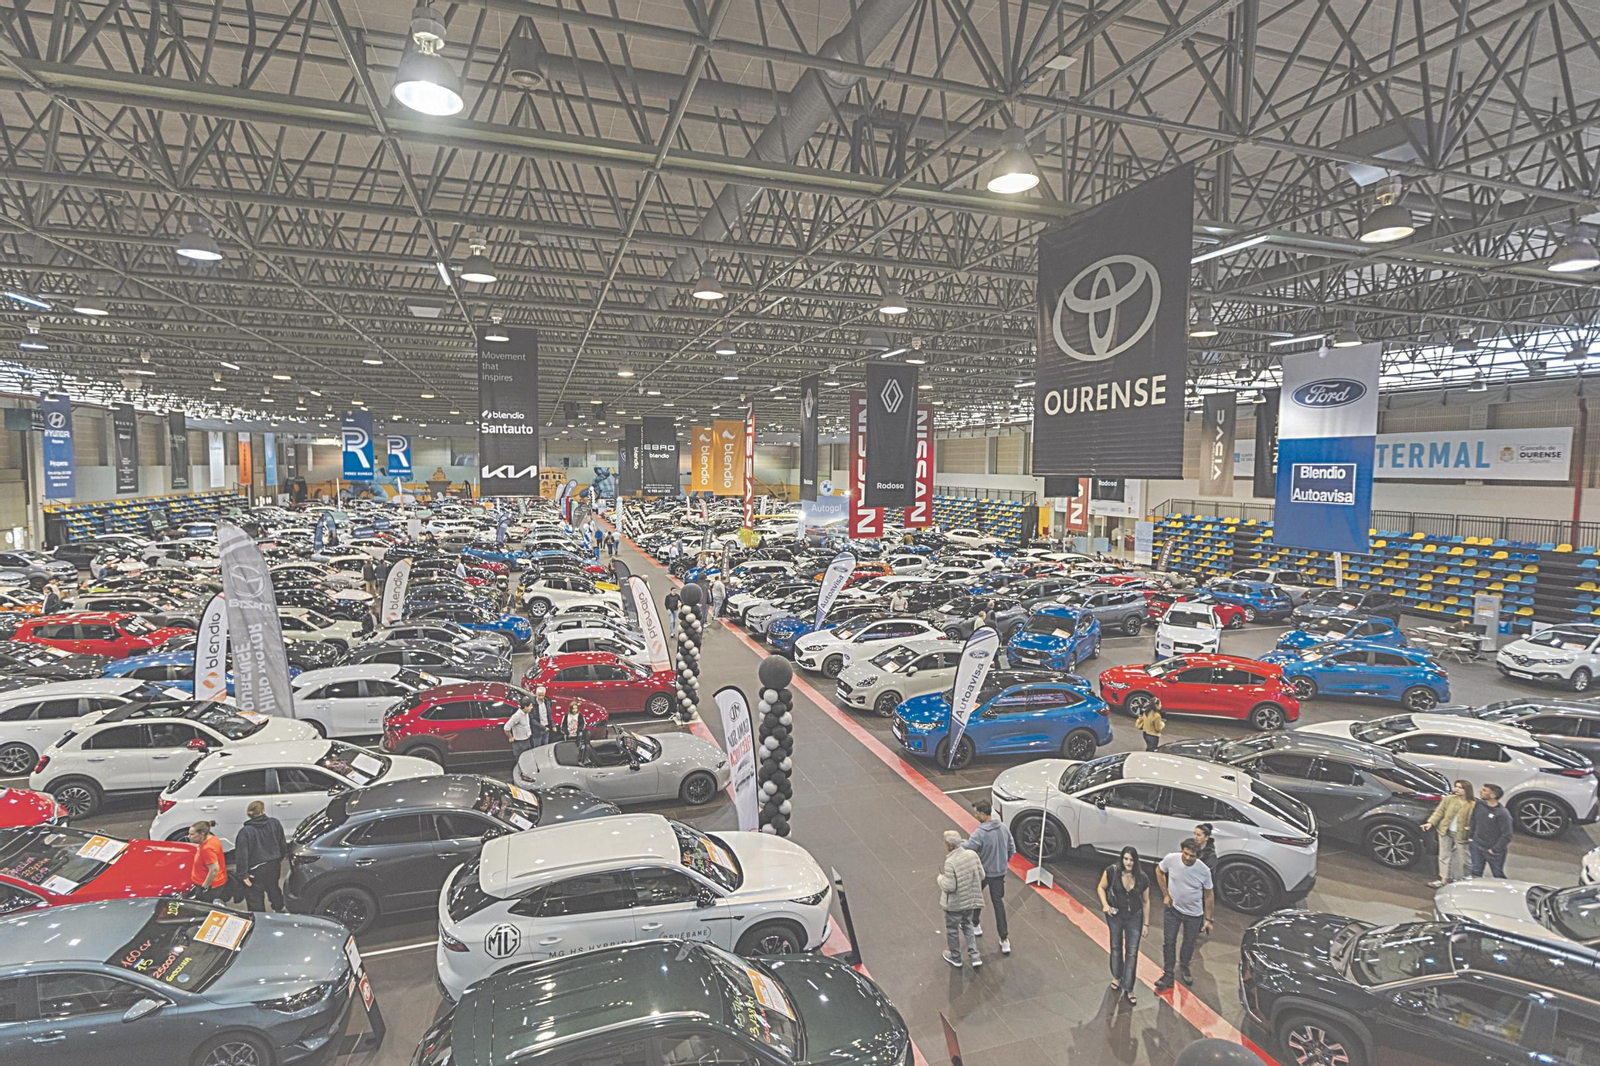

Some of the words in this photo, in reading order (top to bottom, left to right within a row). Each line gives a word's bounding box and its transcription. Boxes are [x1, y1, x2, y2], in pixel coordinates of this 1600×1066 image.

[482, 351, 526, 361] Movement
[482, 362, 499, 370] that
[482, 372, 513, 382] inspires
[1044, 375, 1166, 415] OURENSE
[1305, 379, 1351, 404] Ford
[493, 410, 524, 419] blendio
[481, 422, 533, 434] Santauto
[701, 446, 710, 485] blendio
[724, 443, 734, 488] blendio
[1376, 441, 1490, 468] TERMAL
[1300, 465, 1346, 481] Blendio
[811, 503, 841, 513] Autogal
[1292, 487, 1354, 503] Autoavisa
[392, 571, 403, 610] blendio
[820, 574, 844, 609] Autoavisa
[206, 612, 221, 669] blendio
[956, 663, 984, 719] Autoavisa
[488, 926, 517, 956] MG
